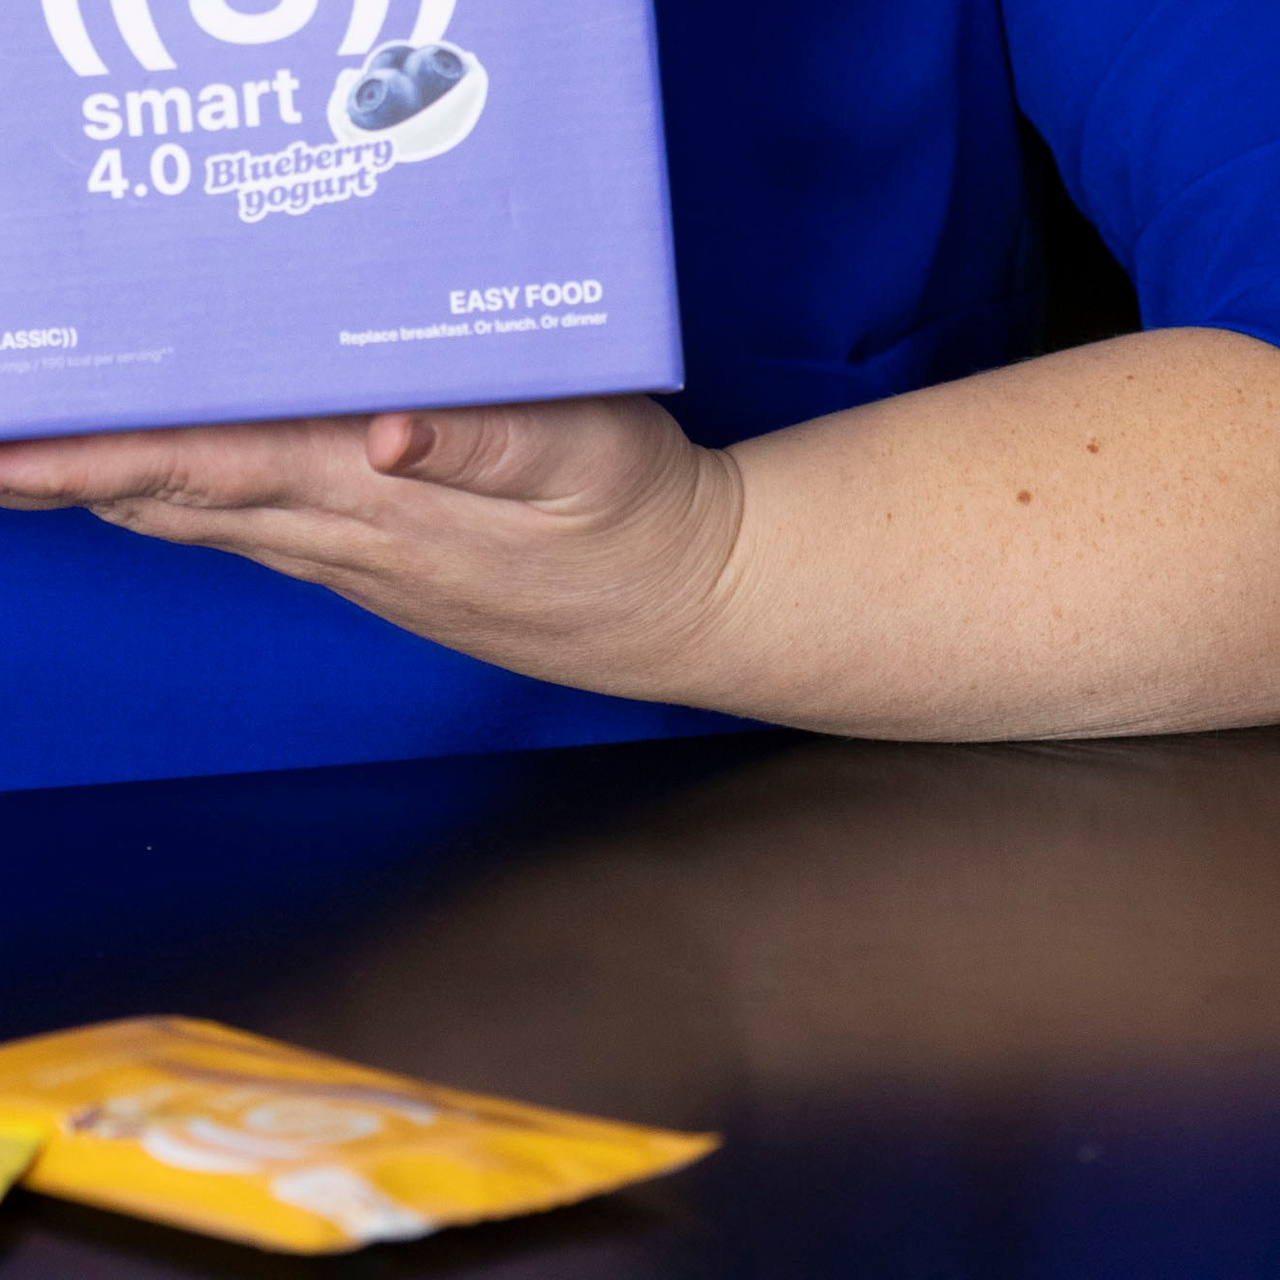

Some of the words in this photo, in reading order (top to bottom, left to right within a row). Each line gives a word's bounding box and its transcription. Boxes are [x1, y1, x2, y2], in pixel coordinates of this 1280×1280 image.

[81, 69, 303, 141] smart
[86, 142, 192, 200] 4.0
[210, 140, 394, 190] Blueberry
[243, 166, 373, 216] yogurt
[449, 286, 520, 315] EASY
[524, 279, 603, 308] FOOD
[339, 329, 399, 347] Replace
[473, 319, 493, 335] Or
[540, 314, 559, 330] Or
[561, 312, 608, 328] dinner
